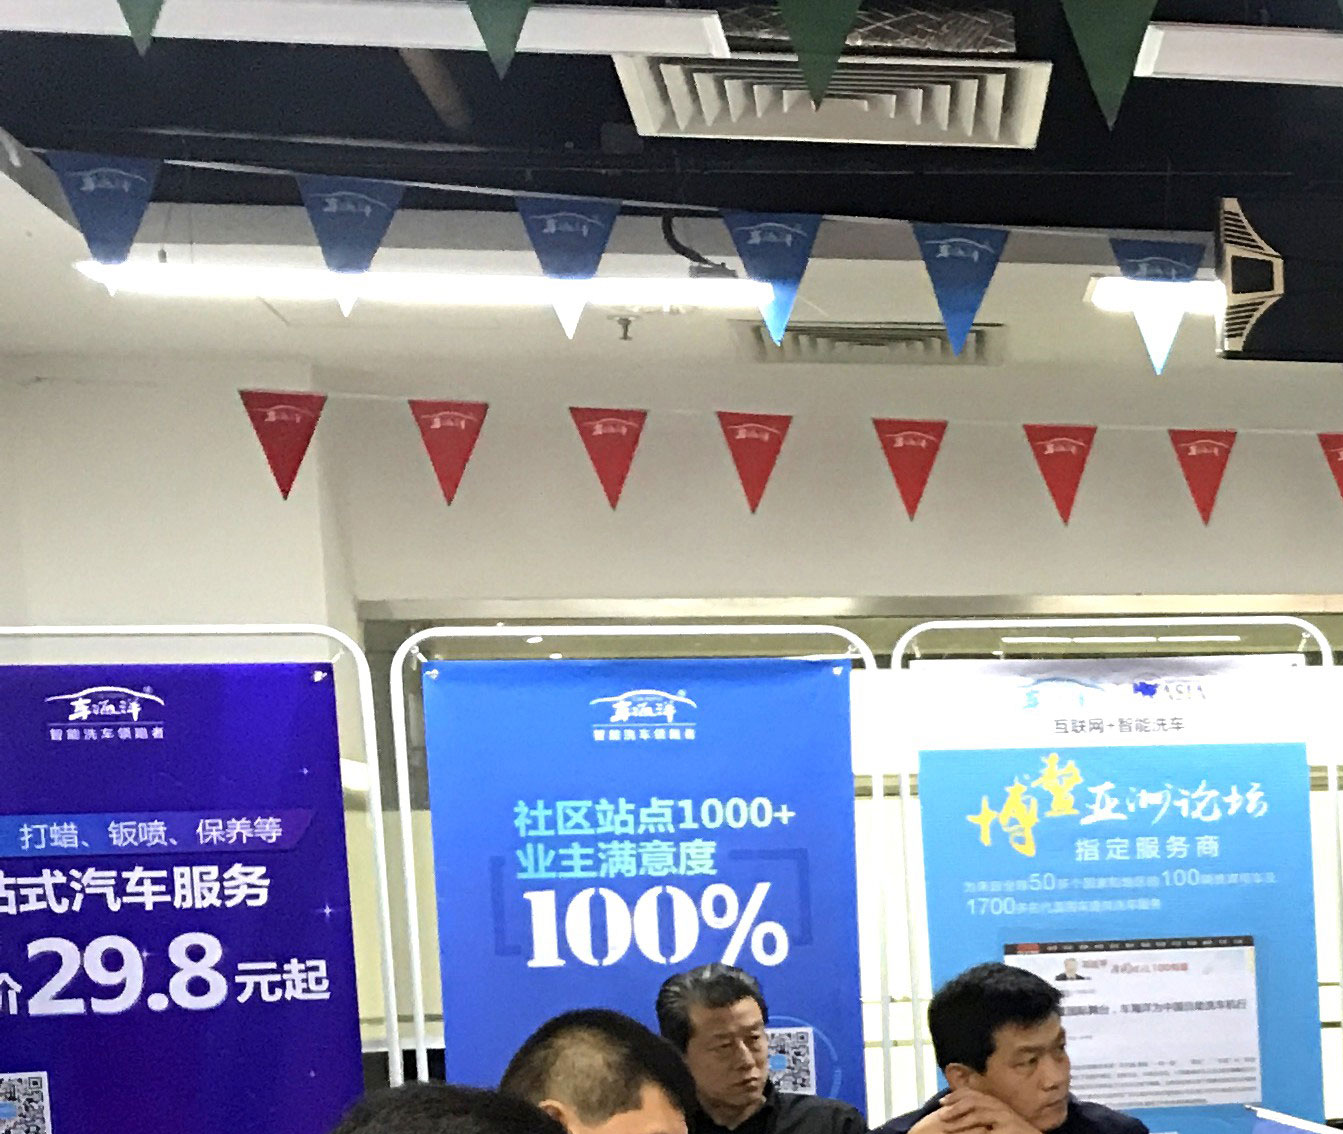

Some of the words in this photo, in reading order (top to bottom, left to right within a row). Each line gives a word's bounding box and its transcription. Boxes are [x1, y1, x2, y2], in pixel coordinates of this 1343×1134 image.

[512, 796, 796, 837] 社区站点1000+
[516, 838, 718, 879] 业主满意度
[1074, 834, 1220, 862] 指定服务商
[522, 881, 790, 968] 100%
